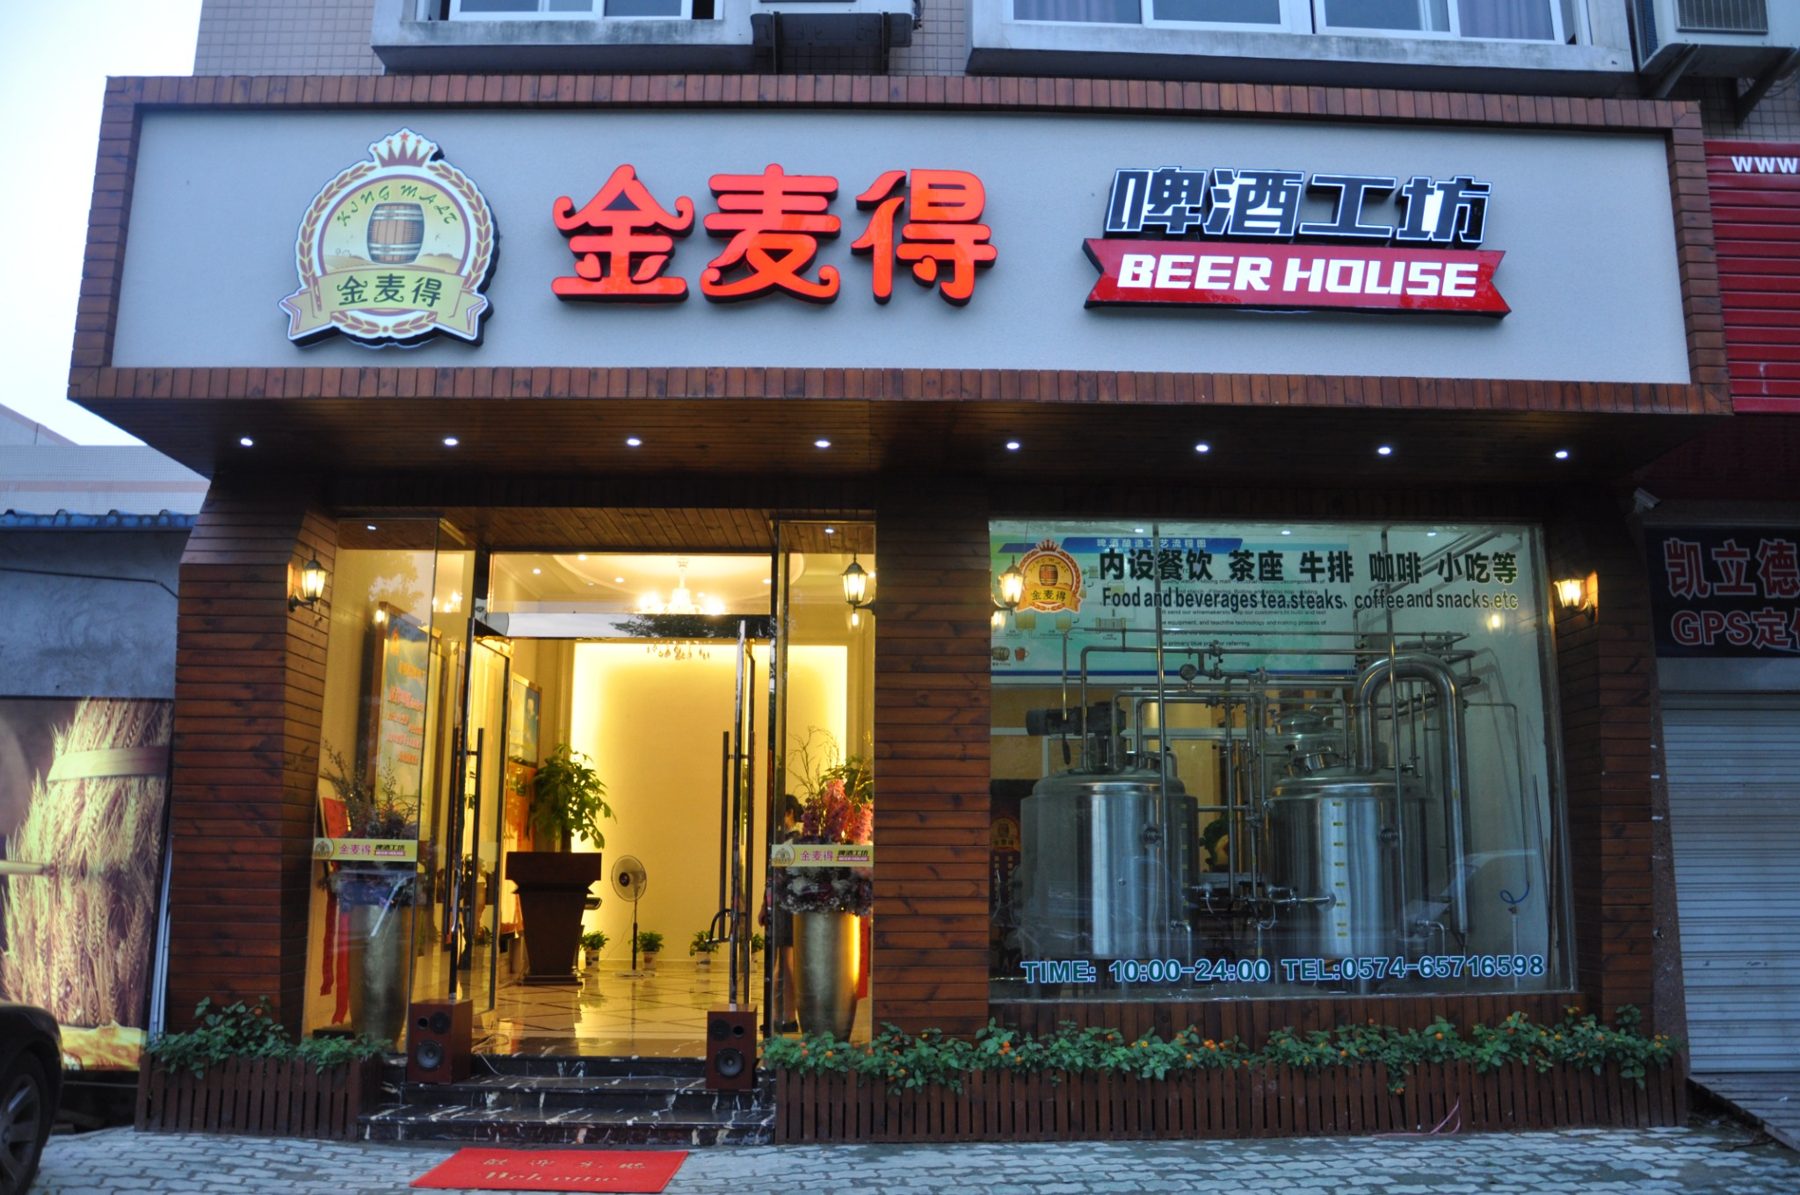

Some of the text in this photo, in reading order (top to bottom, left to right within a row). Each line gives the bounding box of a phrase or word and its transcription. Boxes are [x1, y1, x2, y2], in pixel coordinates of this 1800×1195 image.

[337, 184, 457, 227] KING MALT
[1103, 166, 1493, 246] 啤酒工坊
[551, 163, 998, 305] 金麦得
[337, 273, 443, 308] 金麦得
[1117, 254, 1480, 298] BEER HOUSE
[1100, 548, 1518, 584] 内设餐饮 茶座 牛排 咖啡 小吃等
[1663, 537, 1800, 600] 凯立德
[1102, 586, 1141, 607] Food
[1144, 587, 1172, 608] and
[1175, 587, 1258, 613] beverages
[1354, 587, 1403, 609] coffee
[1406, 588, 1433, 609] and
[1020, 955, 1545, 984] TIME: 10:00-24:00 TEL:0574-65716598
